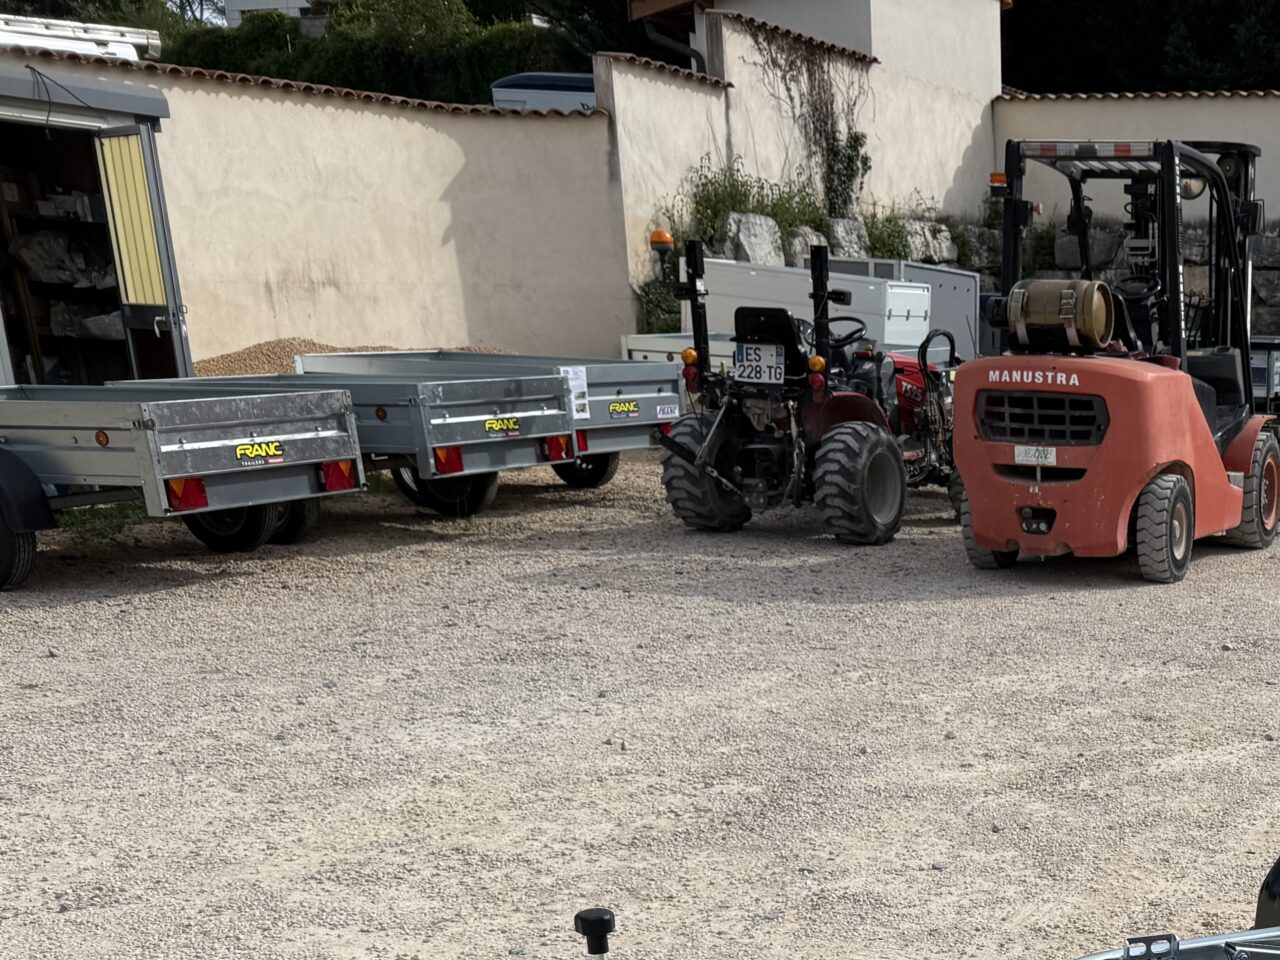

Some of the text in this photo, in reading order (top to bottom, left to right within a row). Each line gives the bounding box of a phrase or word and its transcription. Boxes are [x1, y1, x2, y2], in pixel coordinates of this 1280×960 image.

[746, 346, 762, 363] ES
[988, 370, 1080, 386] MANUSTRA
[608, 401, 639, 413] FRANC
[484, 418, 520, 431] FRANC
[235, 441, 283, 459] FRANC
